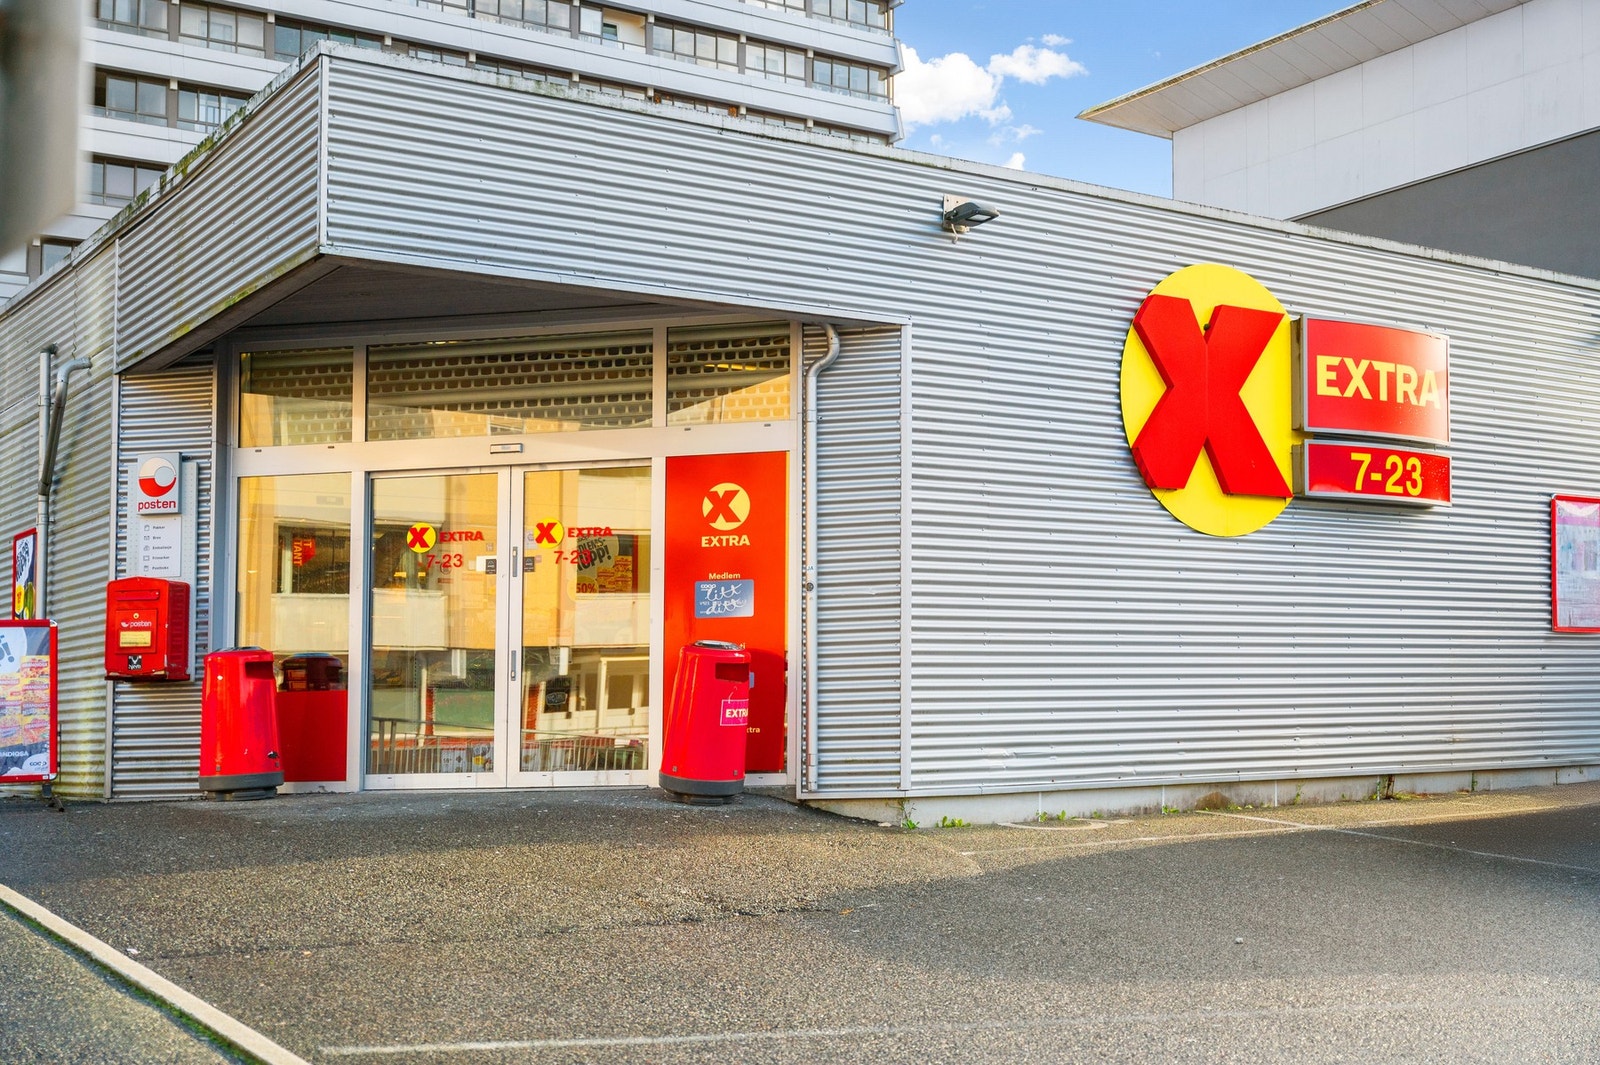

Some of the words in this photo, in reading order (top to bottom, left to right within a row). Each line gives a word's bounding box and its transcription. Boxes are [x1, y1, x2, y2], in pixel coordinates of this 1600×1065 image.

[1315, 354, 1441, 409] EXTRA
[1350, 452, 1423, 496] 7-23
[137, 499, 177, 512] posten
[438, 530, 484, 543] EXTRA
[567, 526, 613, 538] EXTRA
[701, 534, 751, 548] EXTRA
[425, 553, 463, 569] 7-23
[552, 549, 592, 565] 7-23
[708, 571, 741, 580] Medlem
[129, 620, 152, 629] posten
